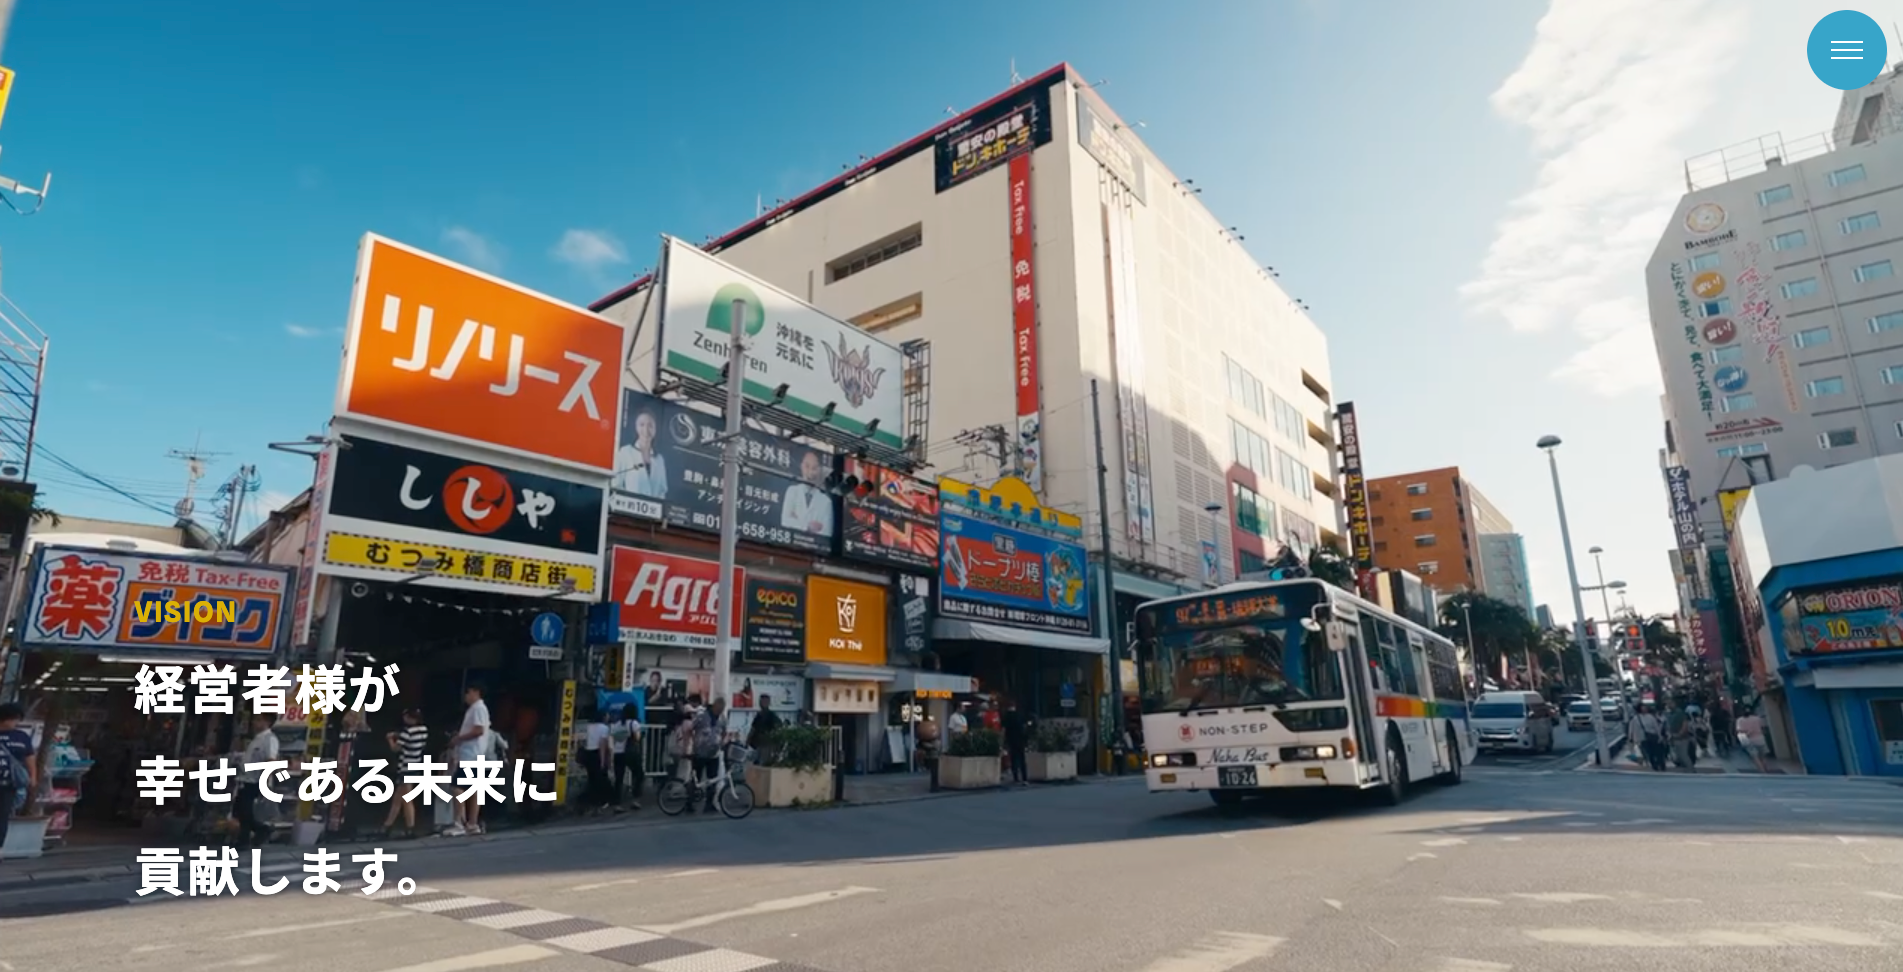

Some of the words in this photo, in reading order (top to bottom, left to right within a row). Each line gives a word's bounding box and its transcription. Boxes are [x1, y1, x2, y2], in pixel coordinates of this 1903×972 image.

[381, 294, 602, 420] リノリース
[693, 331, 768, 374] Zenhren
[776, 342, 814, 371] 元気に
[400, 465, 556, 529] ししや
[706, 514, 791, 543] 01-658-958
[138, 561, 189, 583] 免税
[195, 567, 280, 590] Tax-Free
[366, 543, 568, 586] むつみ橋商店街
[41, 555, 119, 638] 薬
[1826, 586, 1900, 612] ORION
[829, 638, 846, 649] KOI
[1199, 723, 1268, 736] NON-STEP
